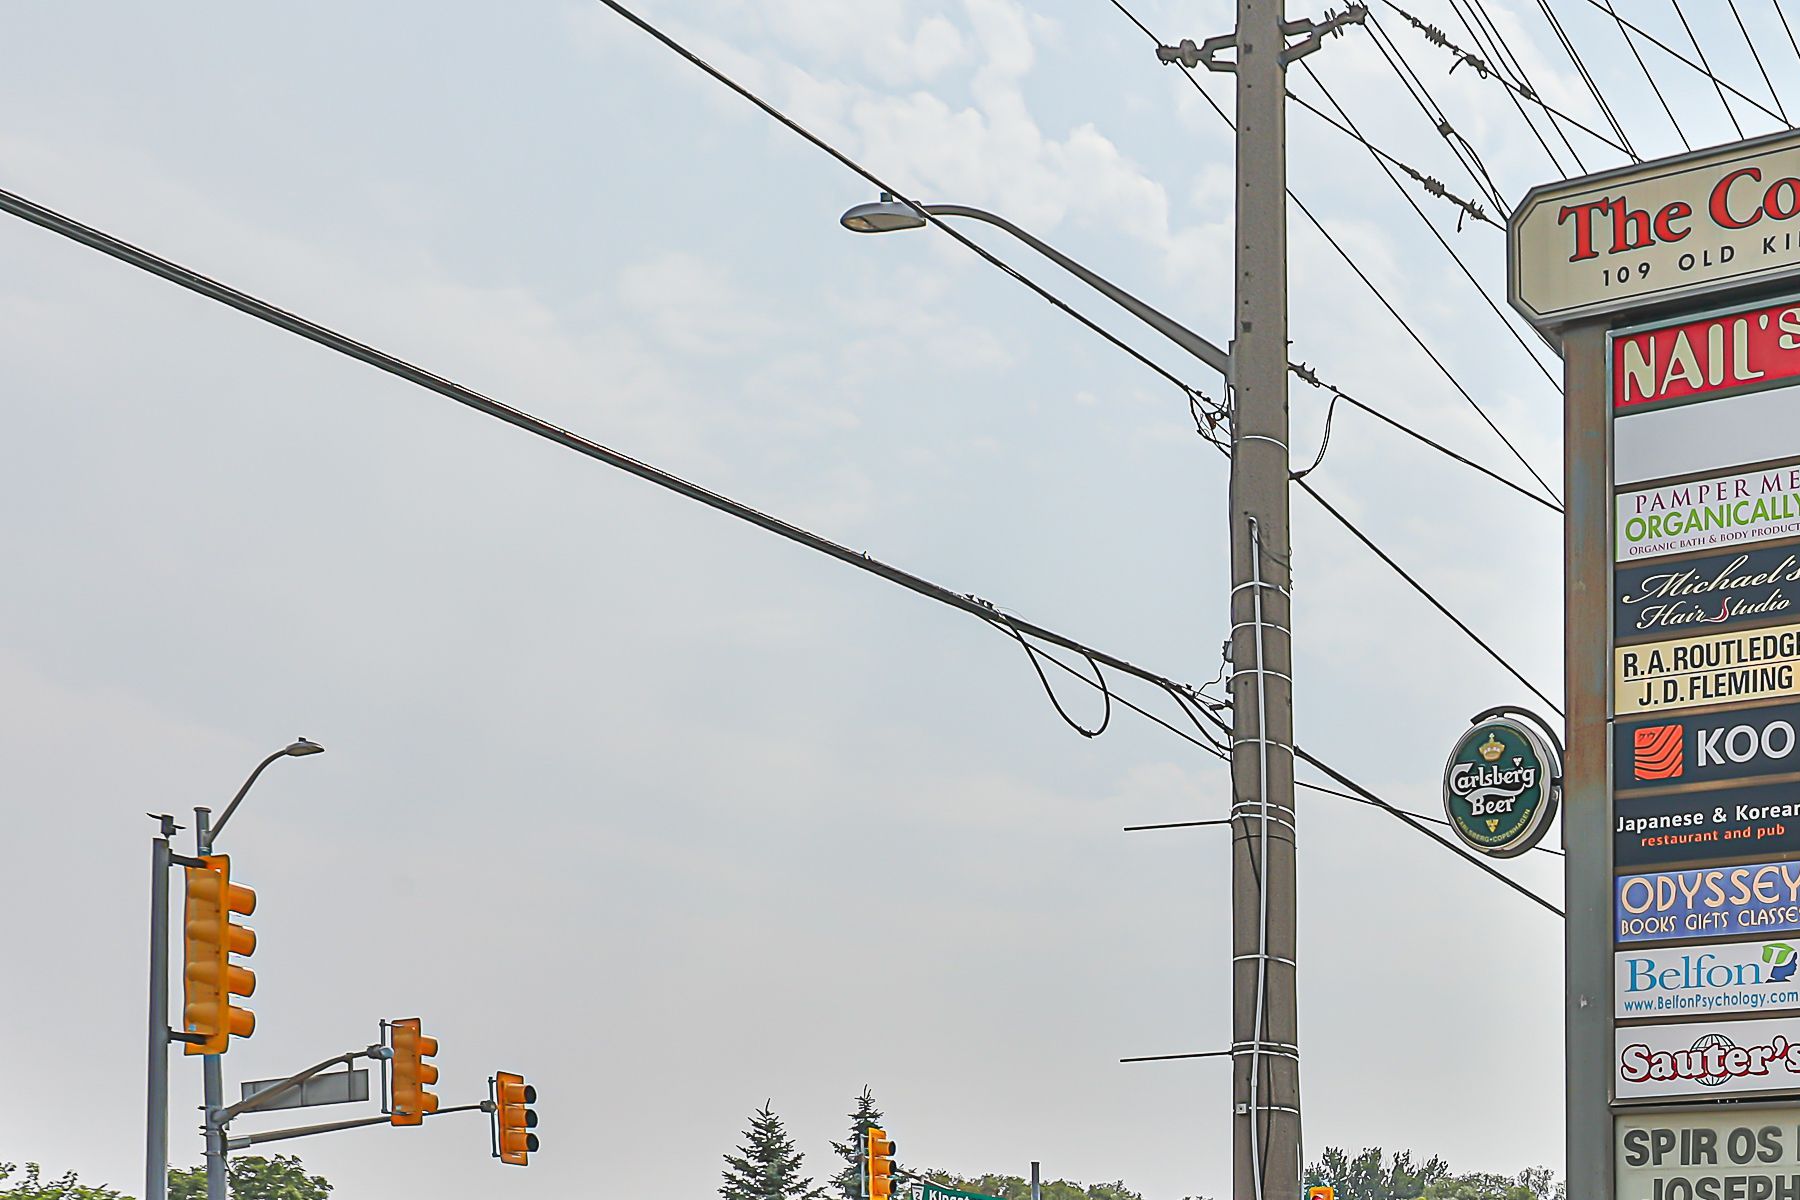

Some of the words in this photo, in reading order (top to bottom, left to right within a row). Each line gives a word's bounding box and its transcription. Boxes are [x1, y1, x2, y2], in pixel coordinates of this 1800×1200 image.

[1557, 194, 1693, 264] The
[1602, 261, 1652, 288] 109
[1677, 245, 1736, 272] OLD
[1634, 478, 1751, 514] PAMPER
[1760, 469, 1800, 495] ME
[1629, 541, 1677, 556] ORGANIC
[1679, 537, 1706, 548] BATH
[1708, 533, 1717, 543] &
[1720, 531, 1749, 542] BODY
[1635, 600, 1705, 630] Hair
[1704, 588, 1792, 624] Studio
[1689, 665, 1793, 701] FLEMING
[1696, 719, 1797, 768] KOO
[1449, 763, 1536, 796] Carlsberg
[1470, 796, 1516, 817] Beer
[1616, 810, 1704, 834] Japanese
[1711, 806, 1728, 823] &
[1641, 830, 1719, 848] restaurant
[1723, 825, 1752, 841] and
[1756, 822, 1786, 841] pub
[1620, 914, 1677, 936] BOOKS
[1685, 910, 1729, 932] GIFTS
[1623, 952, 1764, 993] Belfon
[1623, 989, 1799, 1013] www.BelfonPsychology.com
